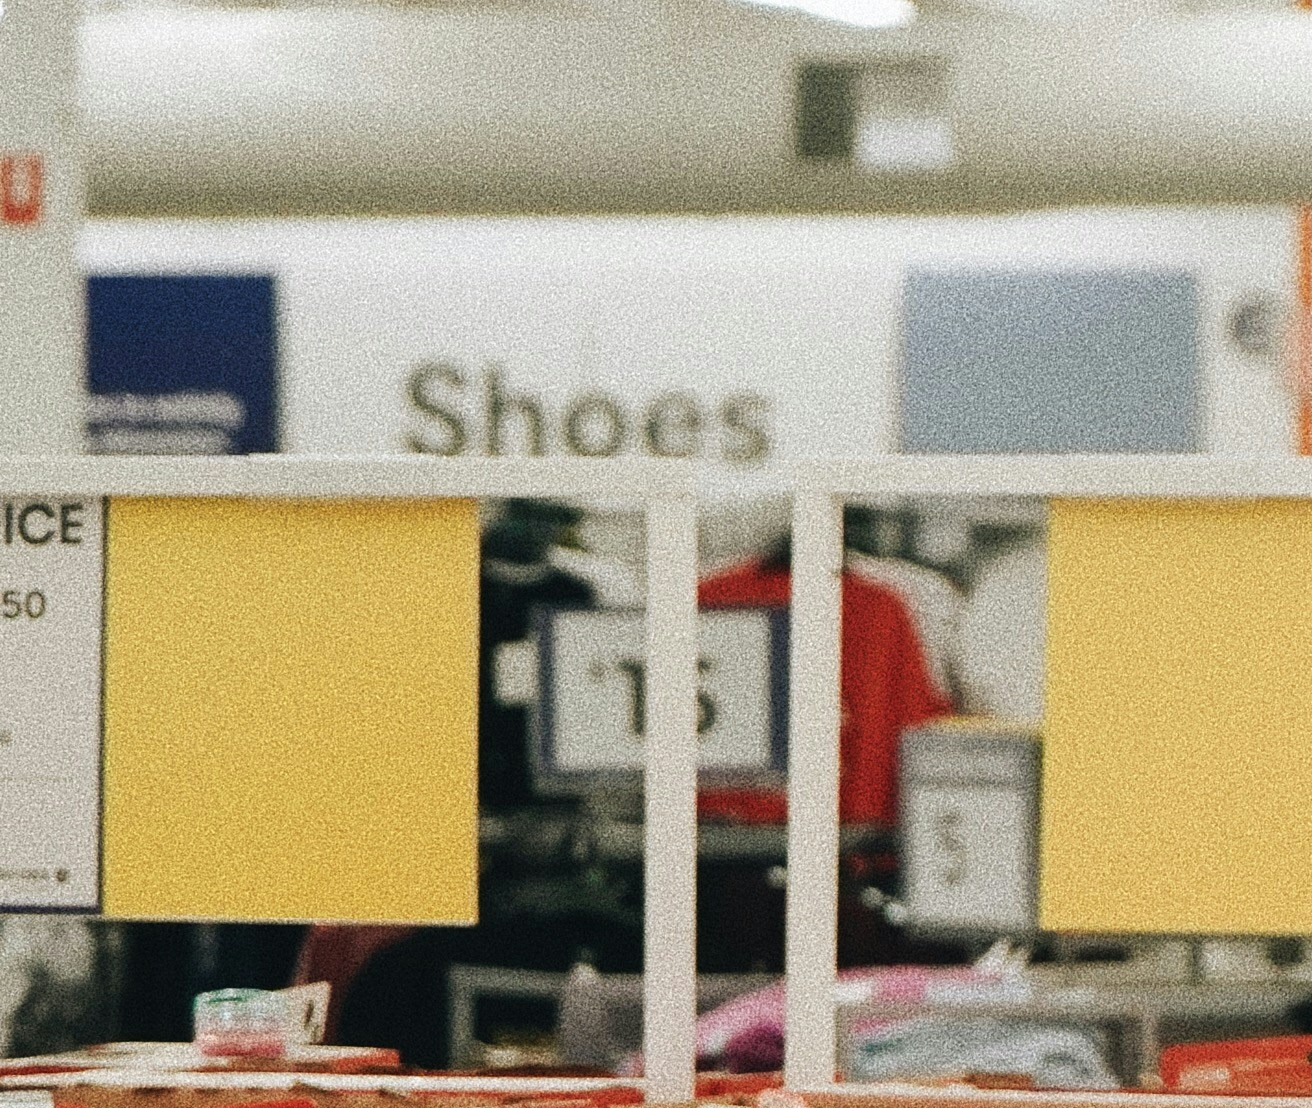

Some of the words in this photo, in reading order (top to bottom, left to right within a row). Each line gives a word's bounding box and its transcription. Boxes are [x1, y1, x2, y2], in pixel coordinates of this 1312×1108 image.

[404, 358, 774, 467] Shoes
[4, 502, 84, 547] ICE
[2, 588, 48, 620] 50
